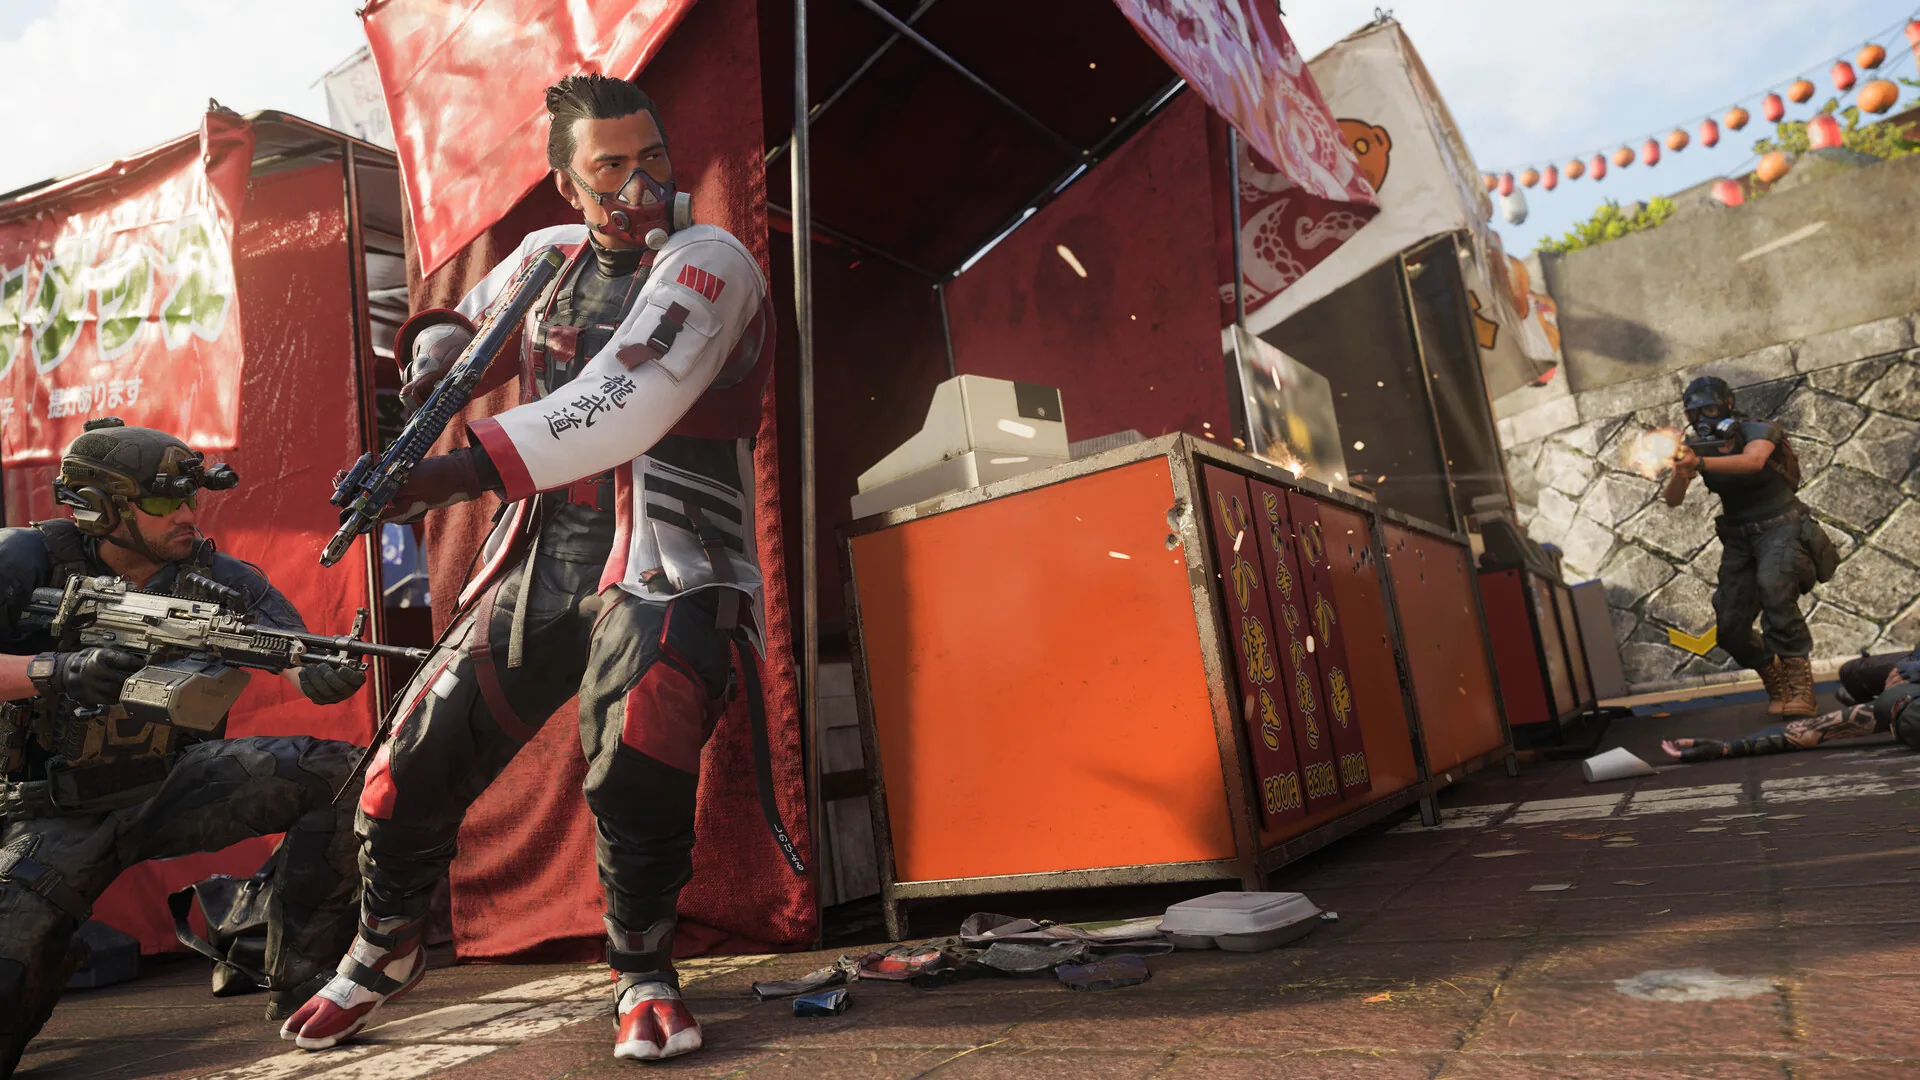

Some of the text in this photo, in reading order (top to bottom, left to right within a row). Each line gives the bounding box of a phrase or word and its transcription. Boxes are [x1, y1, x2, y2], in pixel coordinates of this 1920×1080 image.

[543, 373, 637, 441] 龍武道
[1217, 490, 1282, 751] いか焼き
[1304, 760, 1338, 800] 550円
[1340, 750, 1369, 787] 300円
[1263, 770, 1302, 815] 500円
